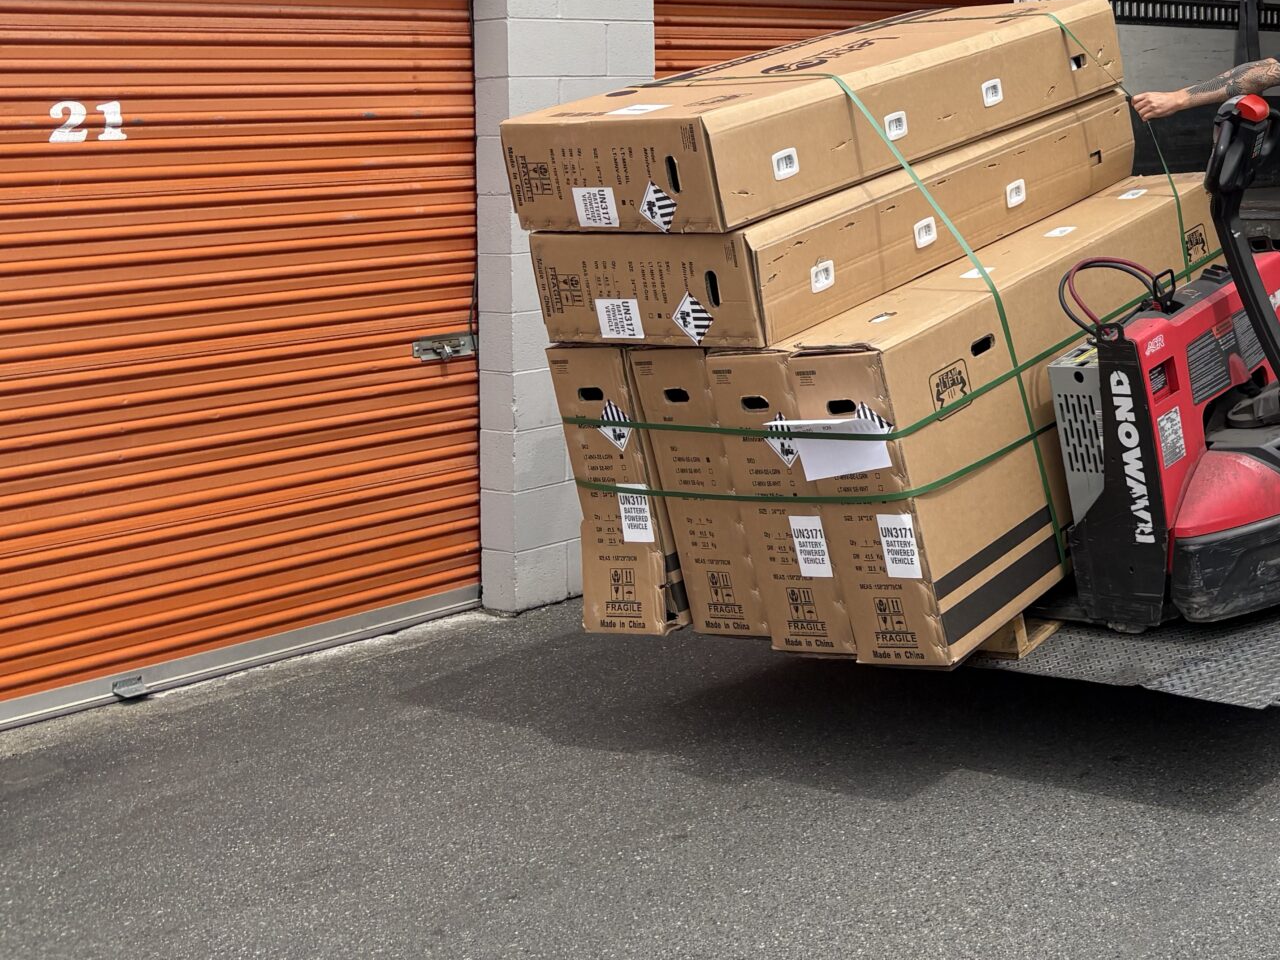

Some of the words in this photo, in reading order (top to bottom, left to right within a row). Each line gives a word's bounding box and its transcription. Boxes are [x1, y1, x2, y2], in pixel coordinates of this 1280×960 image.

[48, 100, 127, 143] 21
[519, 155, 532, 202] FRAGILE
[512, 172, 518, 180] in
[515, 184, 523, 207] China
[581, 194, 591, 220] VEHICLE
[586, 192, 598, 224] POWERED
[597, 189, 612, 225] UN3171
[541, 283, 546, 291] in
[549, 267, 562, 313] FRAGILE
[604, 305, 614, 332] VEHICLE
[610, 303, 621, 335] POWERED
[622, 301, 635, 337] UN3171
[1109, 370, 1156, 544] RAYMOND
[620, 496, 647, 506] UN3171
[793, 528, 823, 539] UN3171
[880, 527, 913, 538] UN3171
[885, 540, 913, 548] BATTERY-
[606, 603, 642, 612] FRAGILE
[708, 605, 743, 614] FRAGILE
[600, 619, 616, 628] Made
[619, 620, 625, 628] in
[629, 620, 645, 628] China
[705, 620, 721, 629] Made
[724, 621, 730, 629] in
[733, 621, 749, 630] China
[788, 622, 827, 631] FRAGILE
[784, 638, 802, 647] Made
[805, 638, 812, 647] in
[815, 639, 834, 647] China
[875, 634, 917, 642] FRAGILE
[872, 650, 891, 658] Made
[894, 651, 901, 659] in
[904, 651, 924, 659] China
